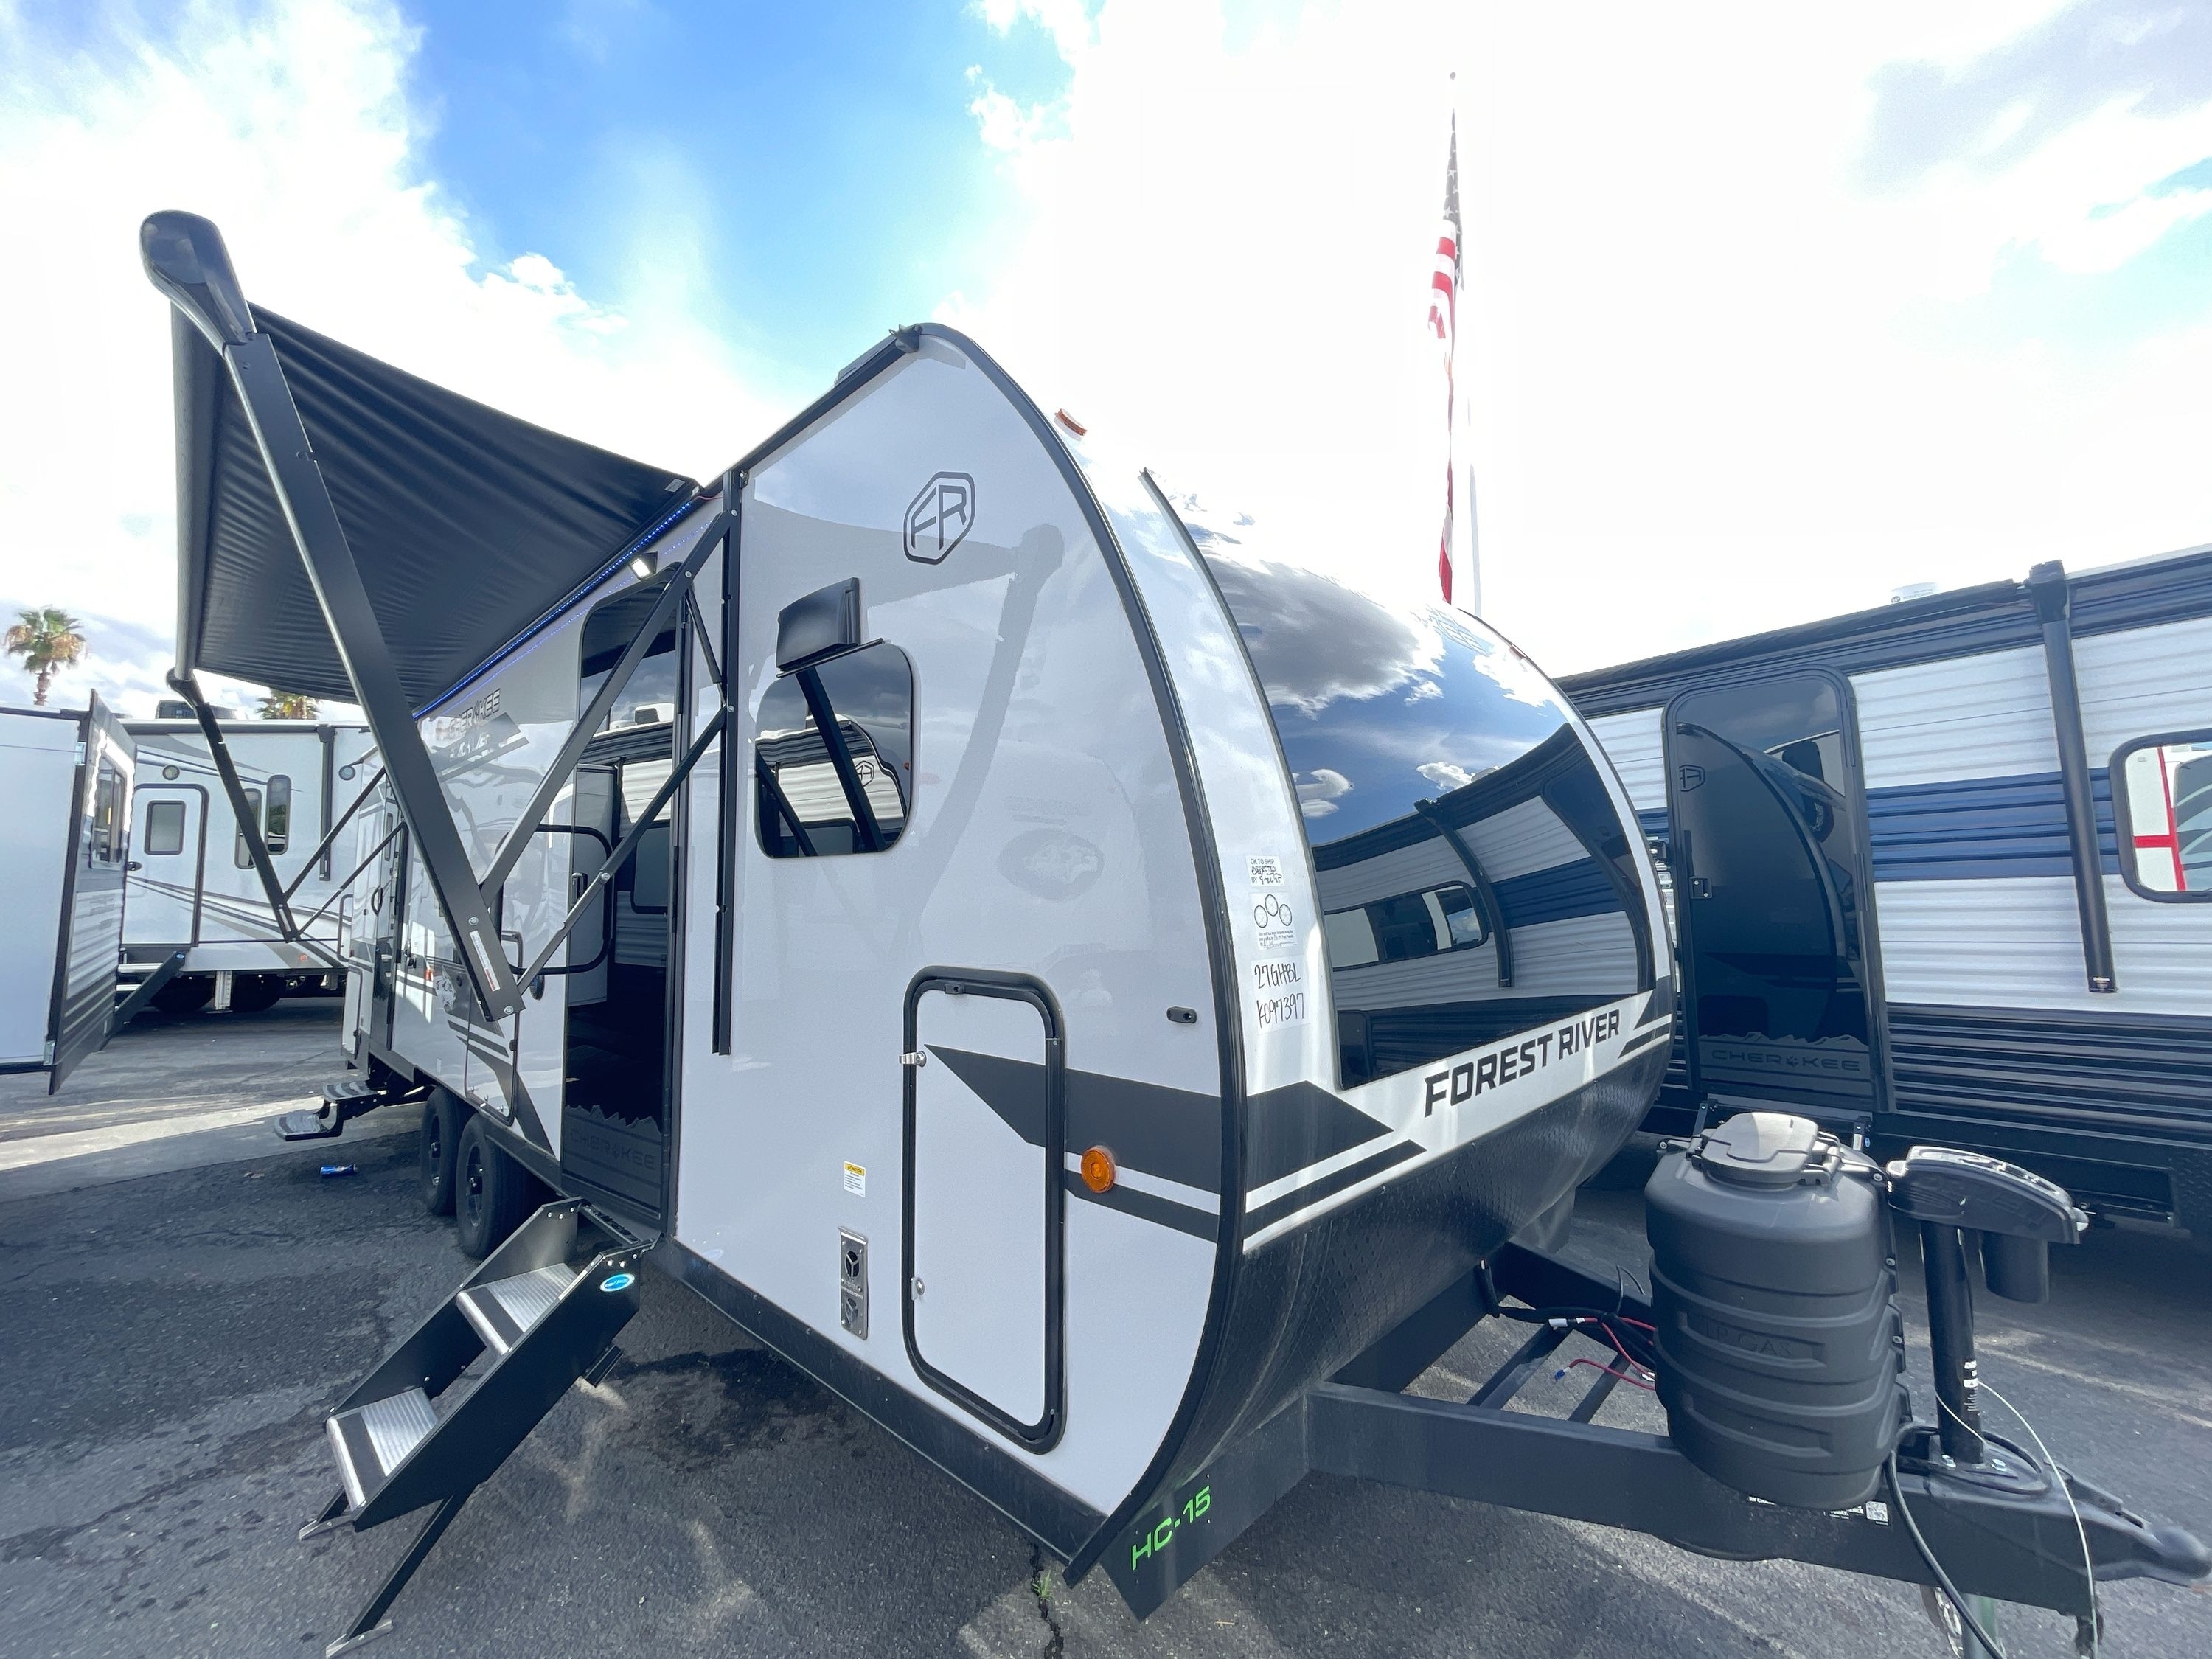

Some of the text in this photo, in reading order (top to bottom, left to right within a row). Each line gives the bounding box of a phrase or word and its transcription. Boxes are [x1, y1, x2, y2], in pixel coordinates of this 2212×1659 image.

[1254, 962, 1301, 990] 27GHBL
[1424, 1009, 1620, 1118] FOREST RIVER
[1711, 1049, 1860, 1071] CHEROKEE
[1738, 1333, 1792, 1359] GAS
[1131, 1486, 1211, 1571] HC-15
